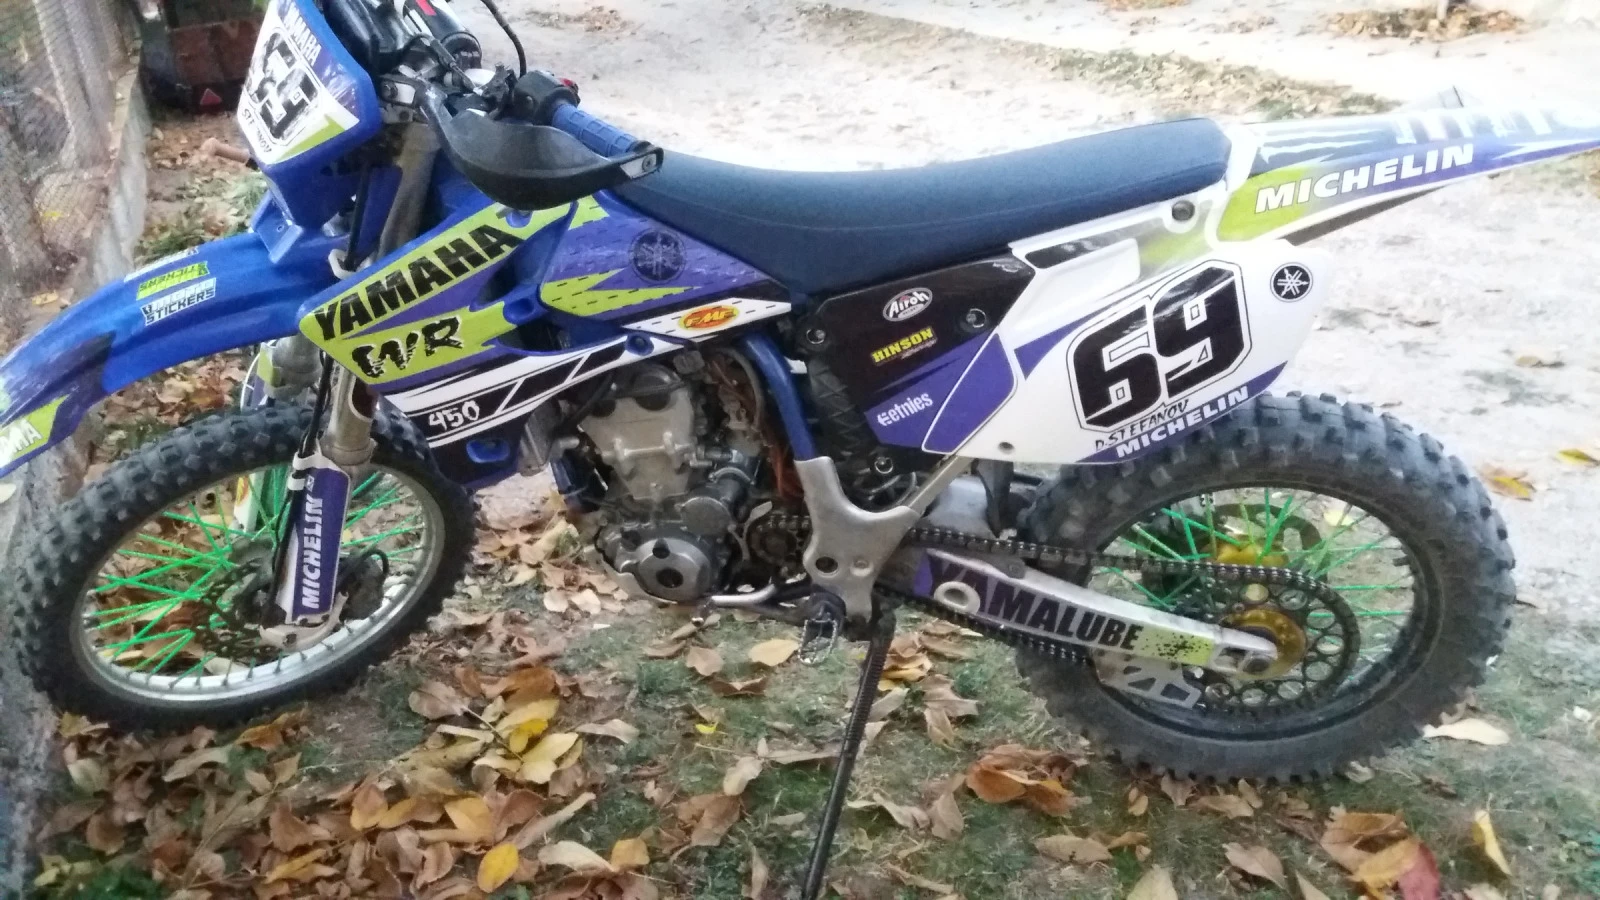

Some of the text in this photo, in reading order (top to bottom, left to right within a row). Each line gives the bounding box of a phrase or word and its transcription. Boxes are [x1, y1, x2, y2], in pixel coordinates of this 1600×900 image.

[1254, 144, 1474, 214] MICHELIN
[145, 286, 214, 324] STICKERS
[313, 224, 525, 341] YAMAHA
[352, 316, 463, 378] WR
[872, 327, 933, 362] HINSON
[1074, 267, 1244, 427] 69
[428, 400, 481, 430] 450
[1116, 386, 1249, 458] MICHELIN
[302, 493, 323, 609] MICHELIN
